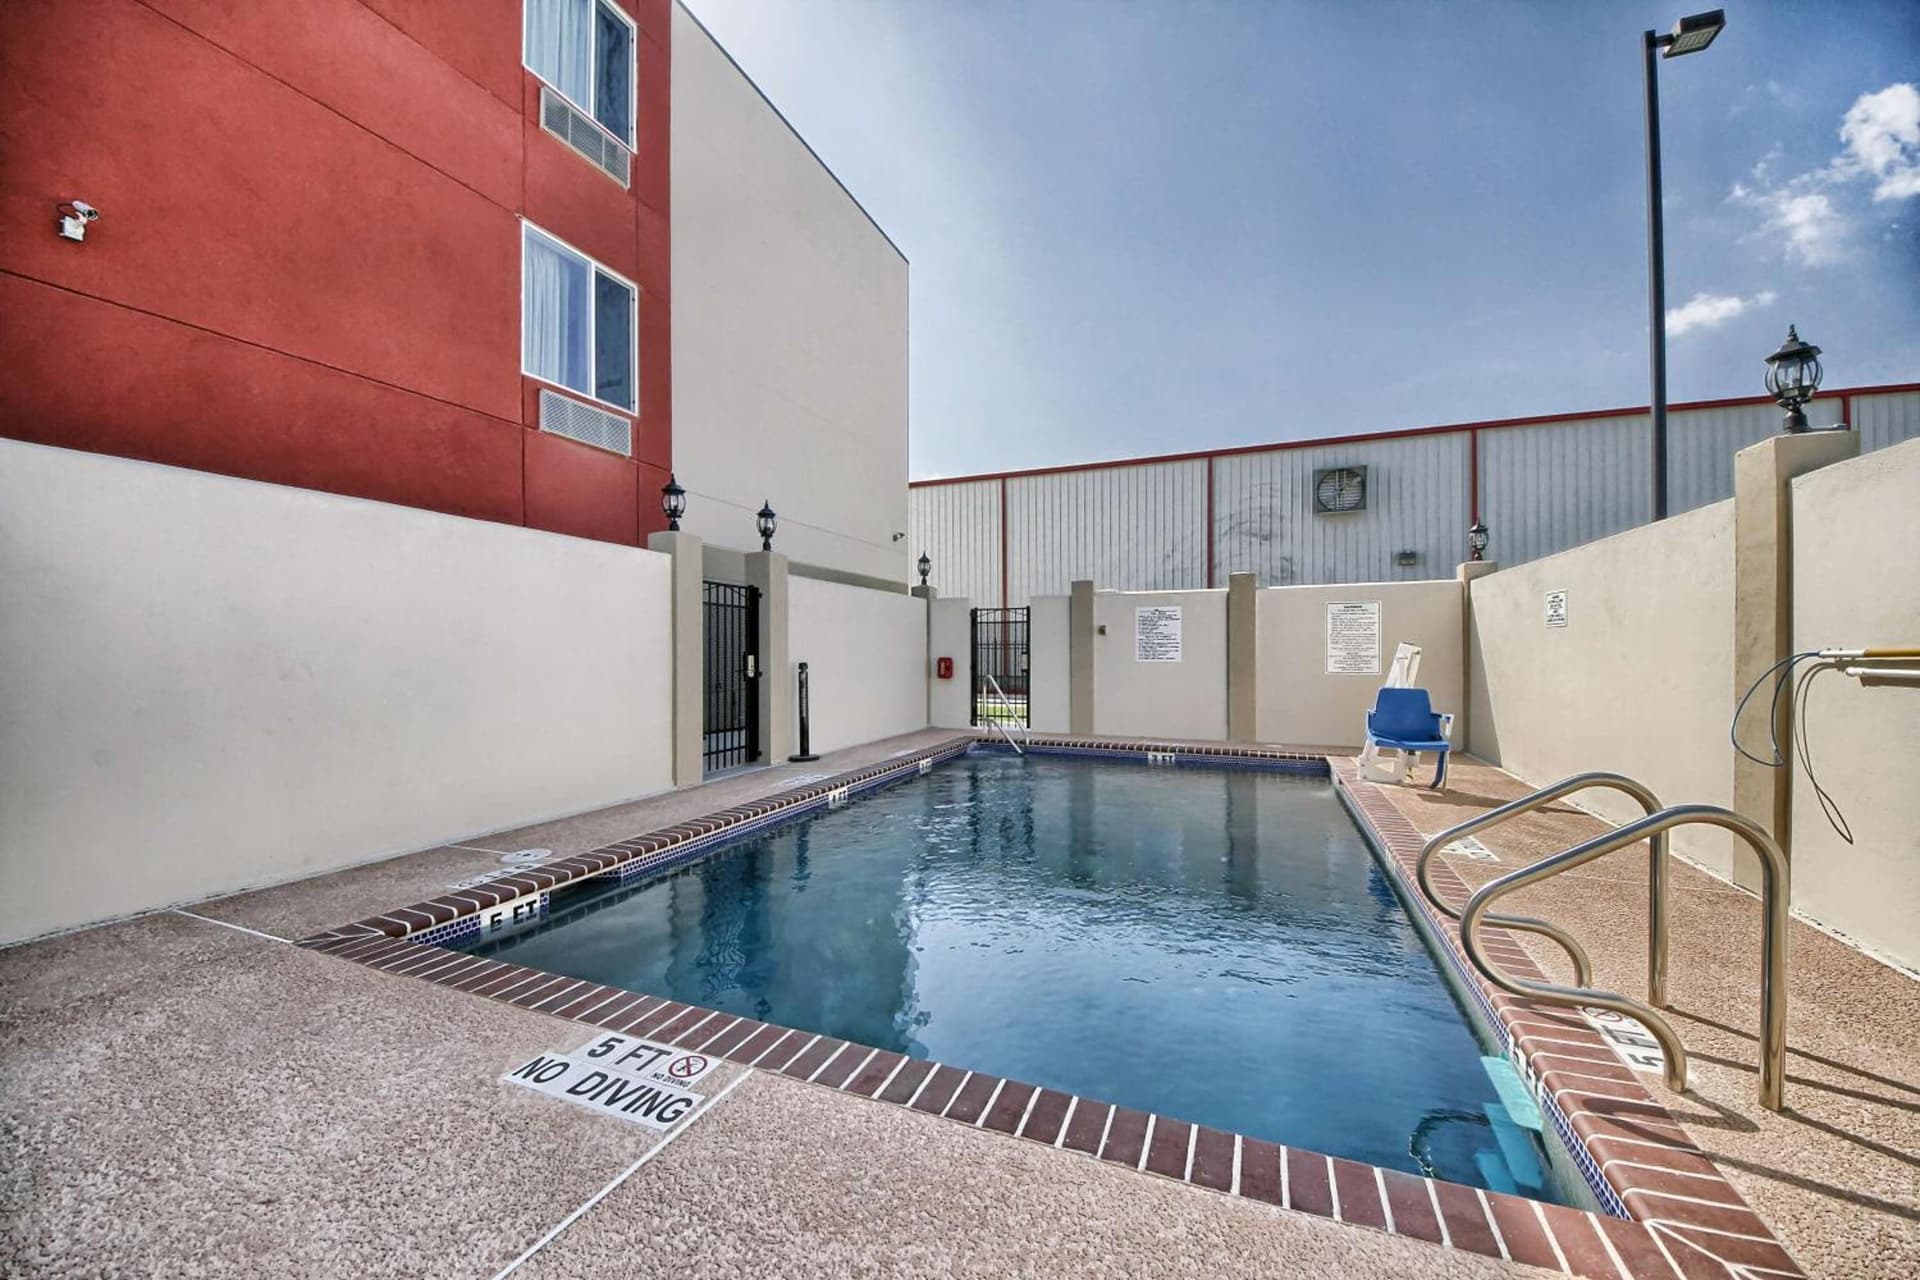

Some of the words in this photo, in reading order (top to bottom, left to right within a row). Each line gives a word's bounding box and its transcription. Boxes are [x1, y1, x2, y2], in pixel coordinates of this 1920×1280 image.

[513, 900, 537, 920] FT
[587, 1037, 625, 1058] 5
[614, 1044, 673, 1071] FT
[512, 1056, 570, 1084] NO
[566, 1071, 693, 1123] DIVING
[651, 1072, 664, 1080] NO
